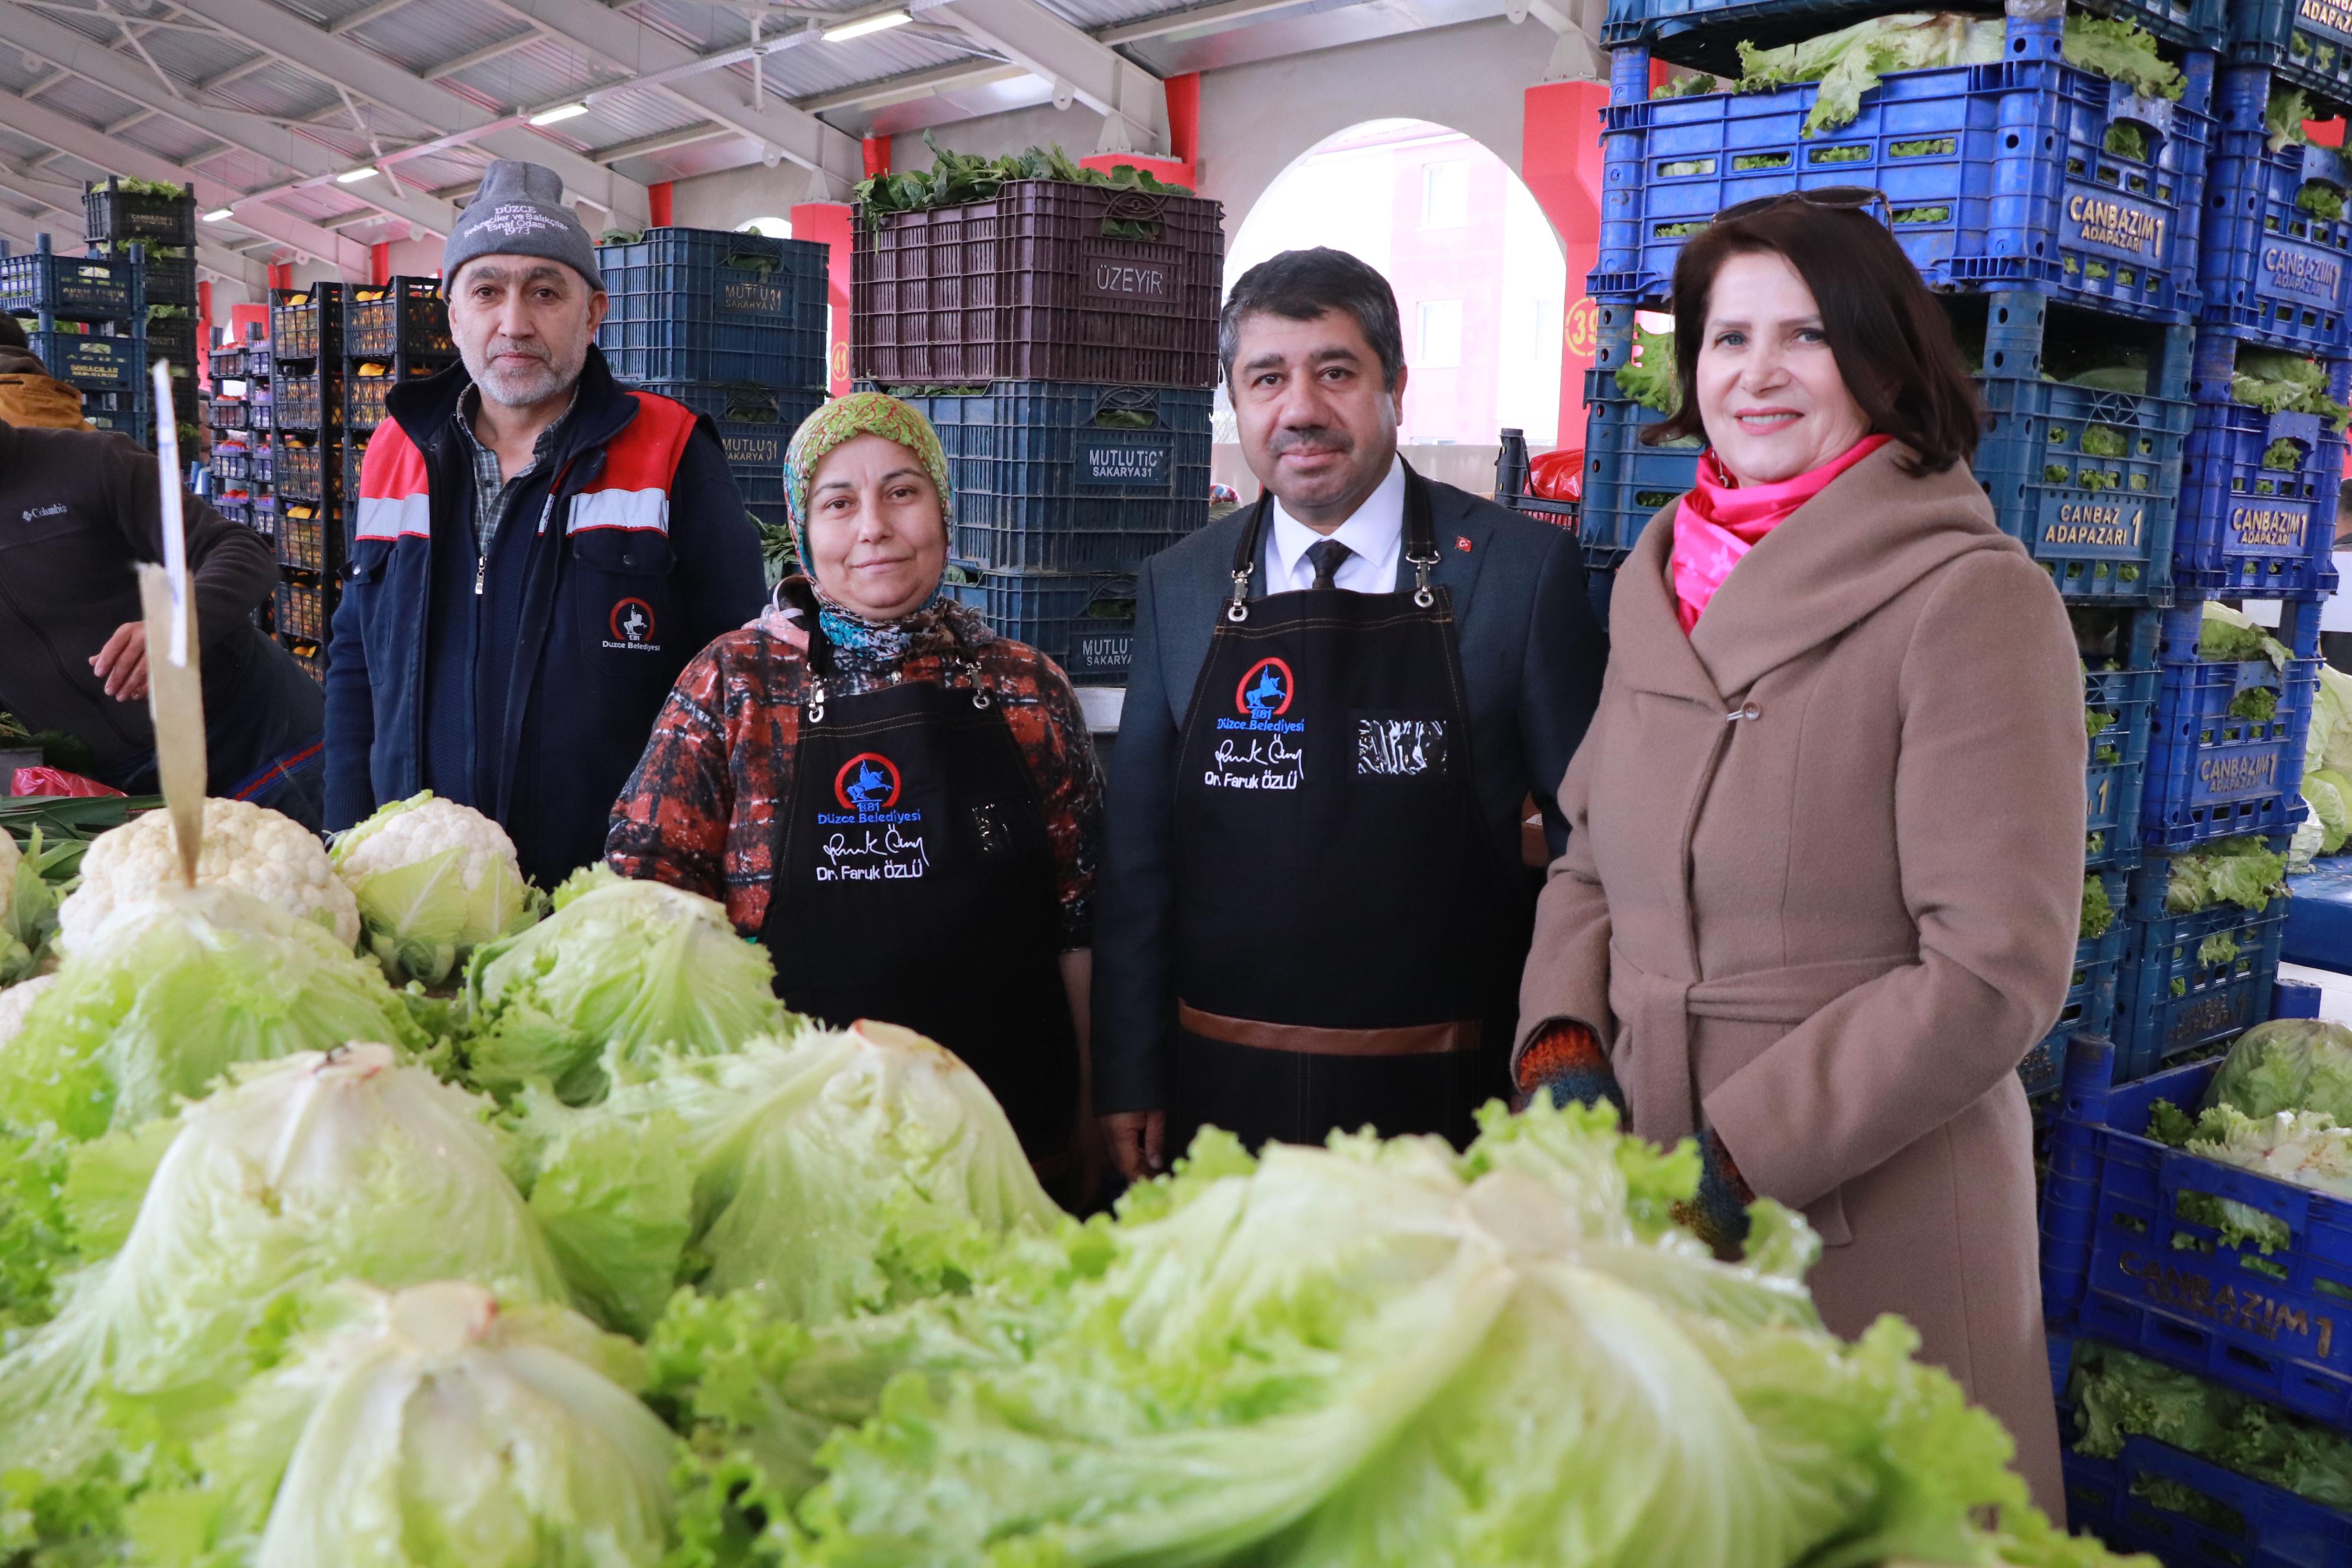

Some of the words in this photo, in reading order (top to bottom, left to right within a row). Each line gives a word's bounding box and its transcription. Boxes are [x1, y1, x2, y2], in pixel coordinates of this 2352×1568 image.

[2301, 0, 2352, 34] ADAPAZ
[495, 204, 537, 215] DÜZCE
[464, 213, 510, 237] Sebzeciler
[525, 213, 569, 231] Balıkçılar
[486, 220, 514, 232] Esnaf
[516, 219, 546, 229] Odası
[504, 226, 530, 236] 1973
[2069, 195, 2155, 241] CANBAZIM
[2154, 218, 2165, 258] 1
[2080, 223, 2143, 253] ADAPAZARI
[2266, 248, 2333, 286] CANBAZIM
[2331, 265, 2342, 301] 1
[2273, 273, 2324, 298] ADAPAZARI
[725, 299, 768, 311] SAKARYA
[833, 348, 847, 374] 41
[722, 438, 766, 452] MUTLU
[727, 452, 764, 461] AKARYA
[1089, 449, 1135, 466] MUTLU
[1092, 466, 1141, 478] SAKARYA
[1141, 467, 1152, 477] 31
[31, 503, 68, 518] Columbia
[2044, 525, 2128, 545] ADAPAZARI
[2060, 504, 2121, 525] CANBAZ
[2131, 509, 2143, 547] 1
[2232, 508, 2301, 534] CANBAZIM
[2297, 514, 2308, 546] 1
[2240, 530, 2291, 546] ADAPAZARI
[627, 642, 661, 652] Belediyesi
[1082, 638, 1128, 656] MUTLU
[1217, 718, 1247, 730] Düzce
[1249, 718, 1305, 734] Belediyesi
[1223, 772, 1259, 789] Faruk
[1261, 769, 1298, 789] ÖZLÜ
[2200, 754, 2270, 782] CANBAZIM
[2268, 753, 2278, 785] 1
[2098, 779, 2109, 814] 1
[817, 813, 855, 824] Düzce
[858, 808, 922, 824] Belediyesi
[816, 867, 838, 881] Dr.
[841, 865, 881, 880] Faruk
[883, 858, 923, 878] ÖZLÜ
[2119, 1250, 2309, 1337] CANBAZIM
[2315, 1316, 2334, 1358] 1
